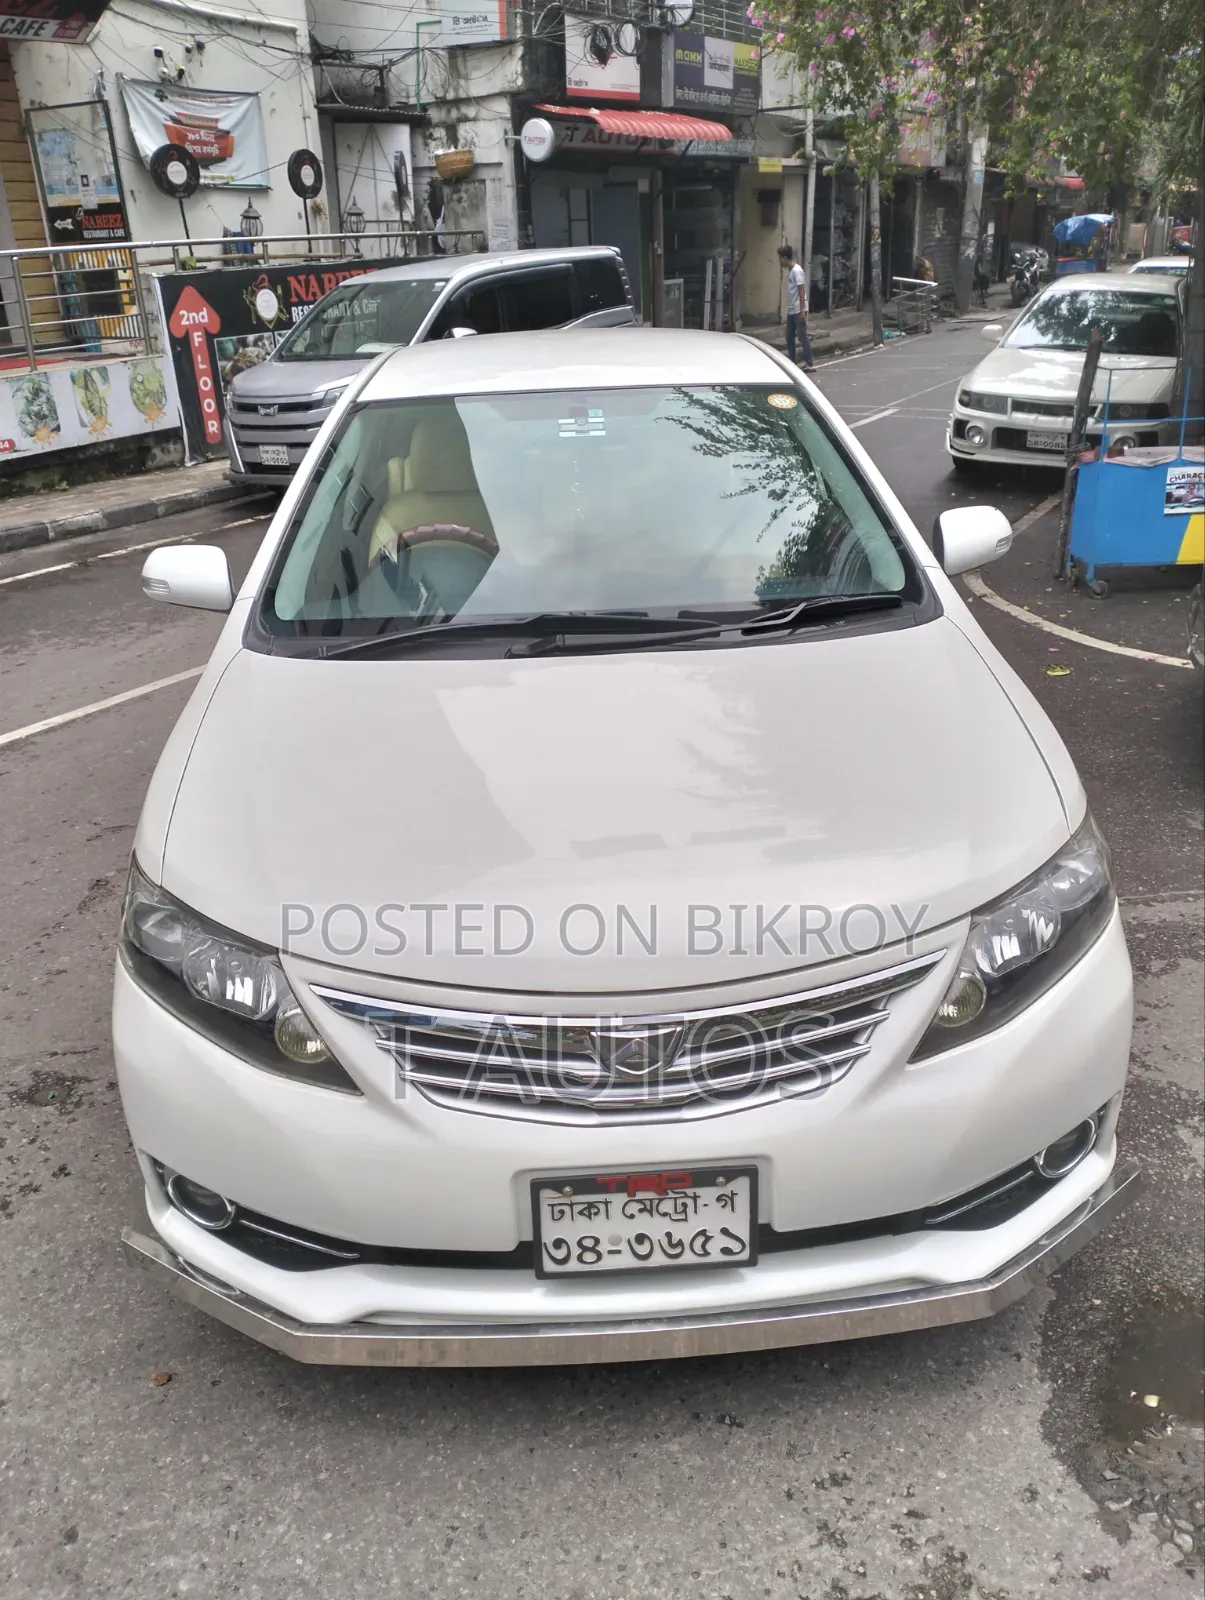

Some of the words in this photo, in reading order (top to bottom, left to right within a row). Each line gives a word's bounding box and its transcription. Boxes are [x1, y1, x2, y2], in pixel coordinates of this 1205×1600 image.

[0, 17, 49, 37] CAFE
[528, 136, 546, 144] AUTOS
[565, 126, 579, 142] T
[179, 307, 209, 325] 2nd
[354, 301, 361, 315] &
[193, 331, 218, 434] FLOOR
[1170, 472, 1205, 483] CHARAC
[547, 1197, 612, 1222] ঢাকা
[543, 1226, 747, 1266] ৩৪-৩৬৫১
